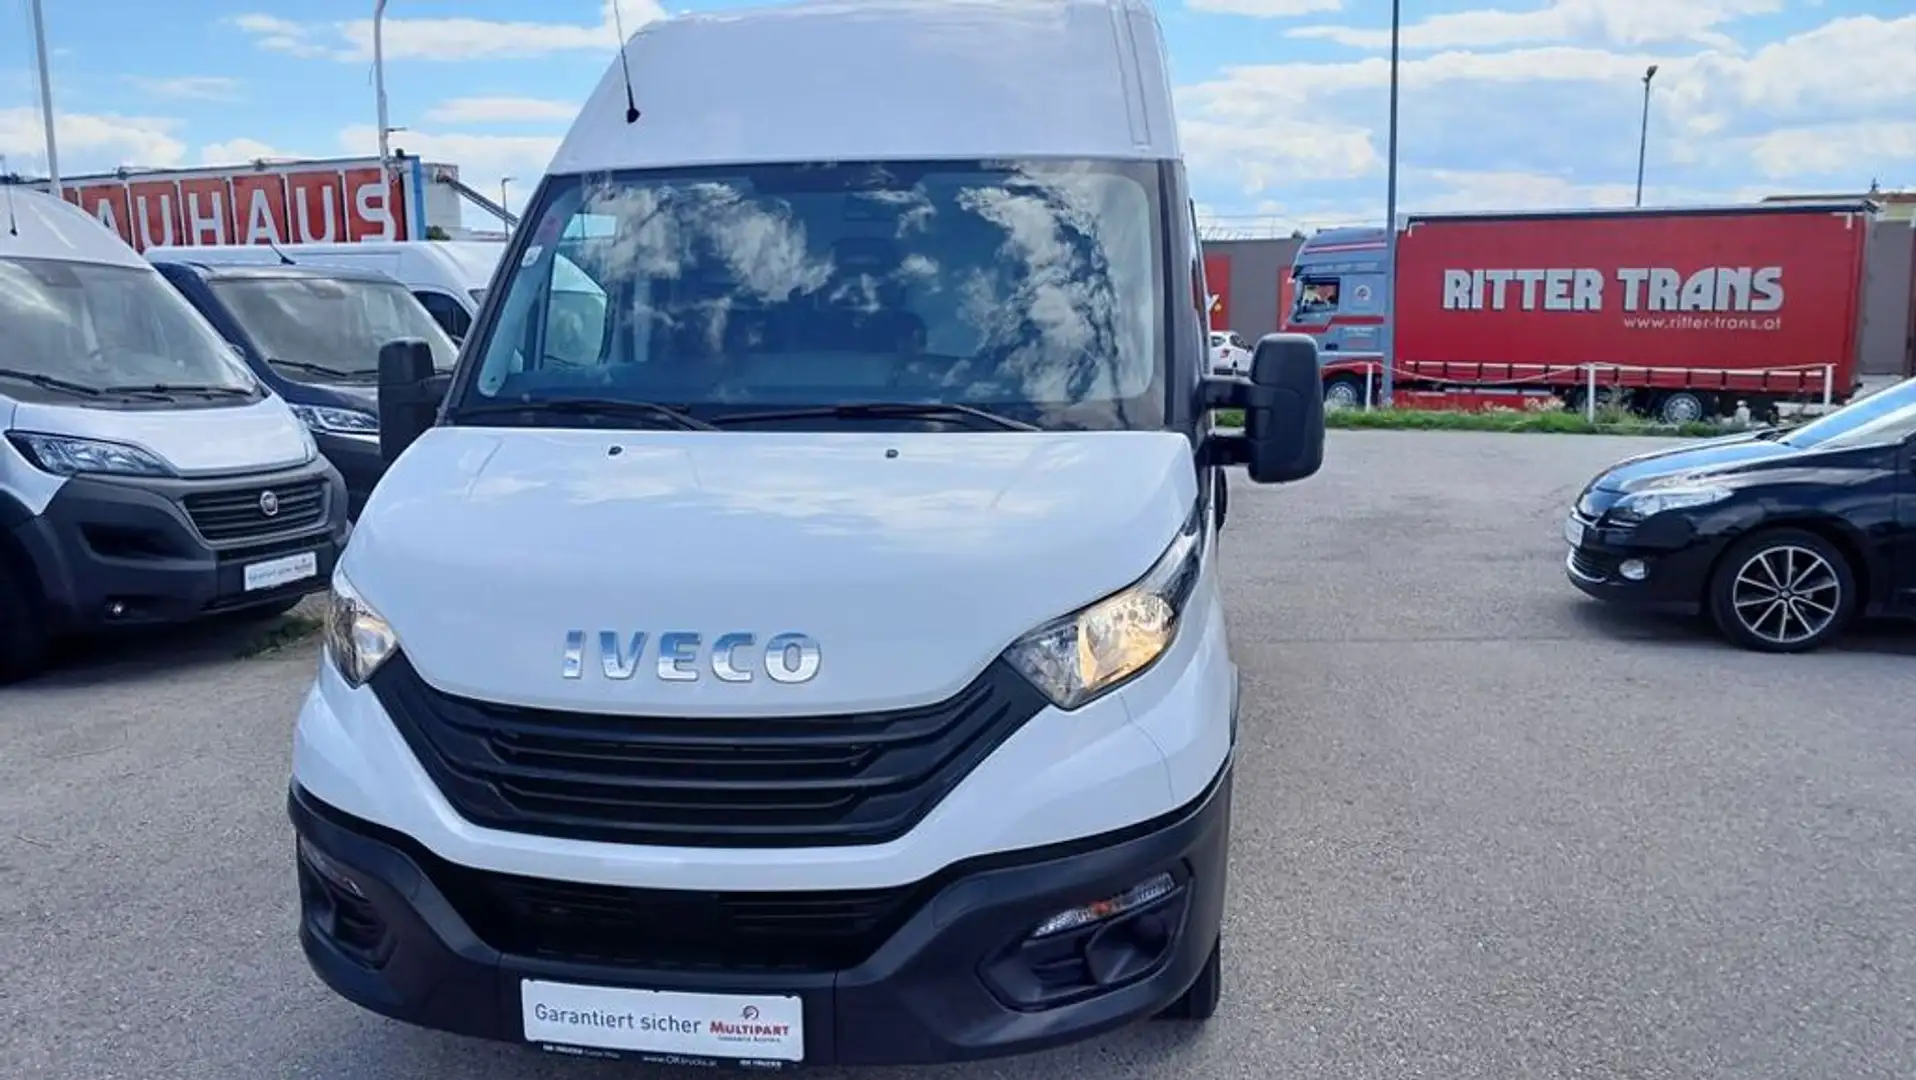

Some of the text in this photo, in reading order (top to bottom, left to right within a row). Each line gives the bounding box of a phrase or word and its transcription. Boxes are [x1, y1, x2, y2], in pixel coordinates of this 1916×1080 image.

[94, 183, 397, 245] AUHAUS
[1443, 266, 1784, 312] RITTER TRANS
[1623, 314, 1781, 330] www.ritter-trans.at
[562, 631, 821, 683] IVECO
[535, 1003, 790, 1037] Garantiert sicher MULTIPART
